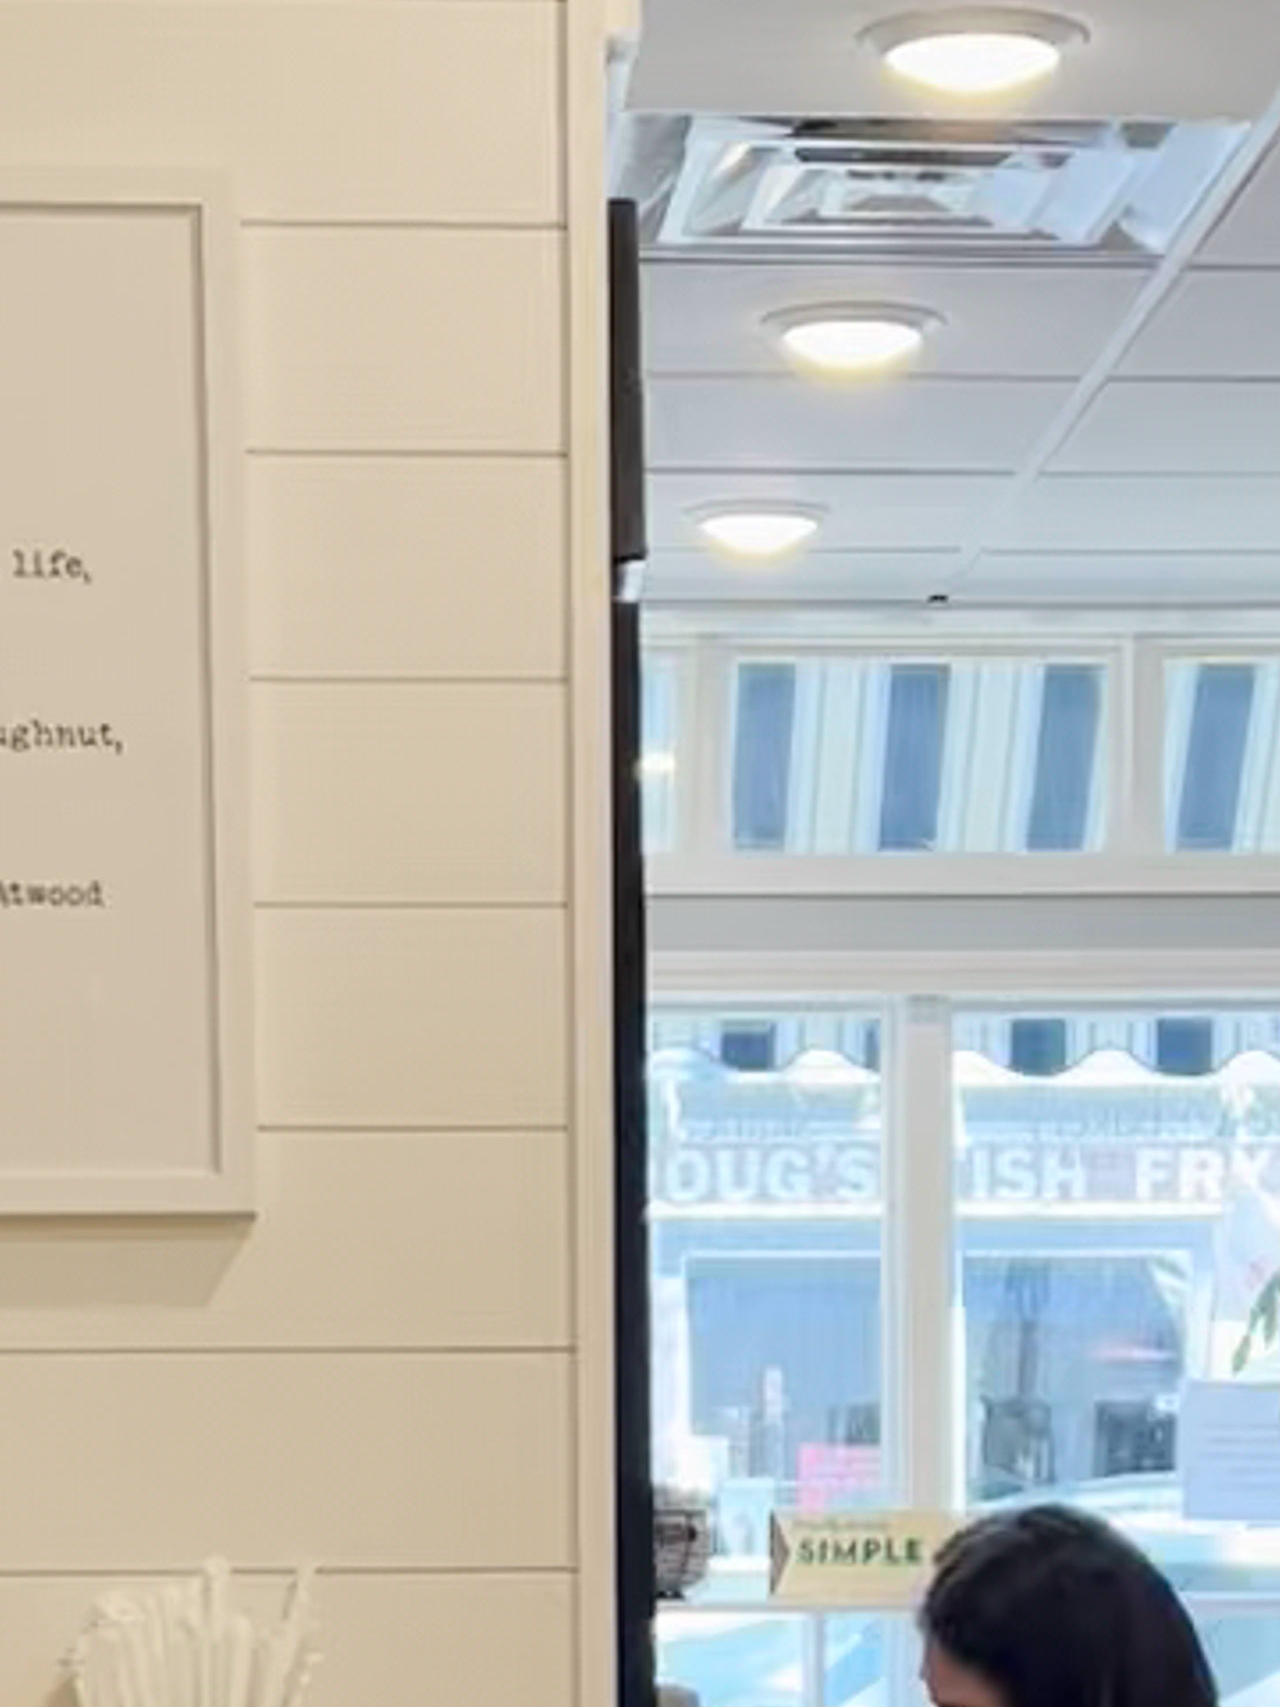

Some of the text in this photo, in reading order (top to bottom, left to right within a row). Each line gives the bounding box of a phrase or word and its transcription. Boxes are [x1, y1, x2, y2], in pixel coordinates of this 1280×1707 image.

[11, 548, 93, 586] life,
[665, 1143, 1276, 1201] OUG'S ISH FRY
[794, 1536, 923, 1566] SIMPLE
